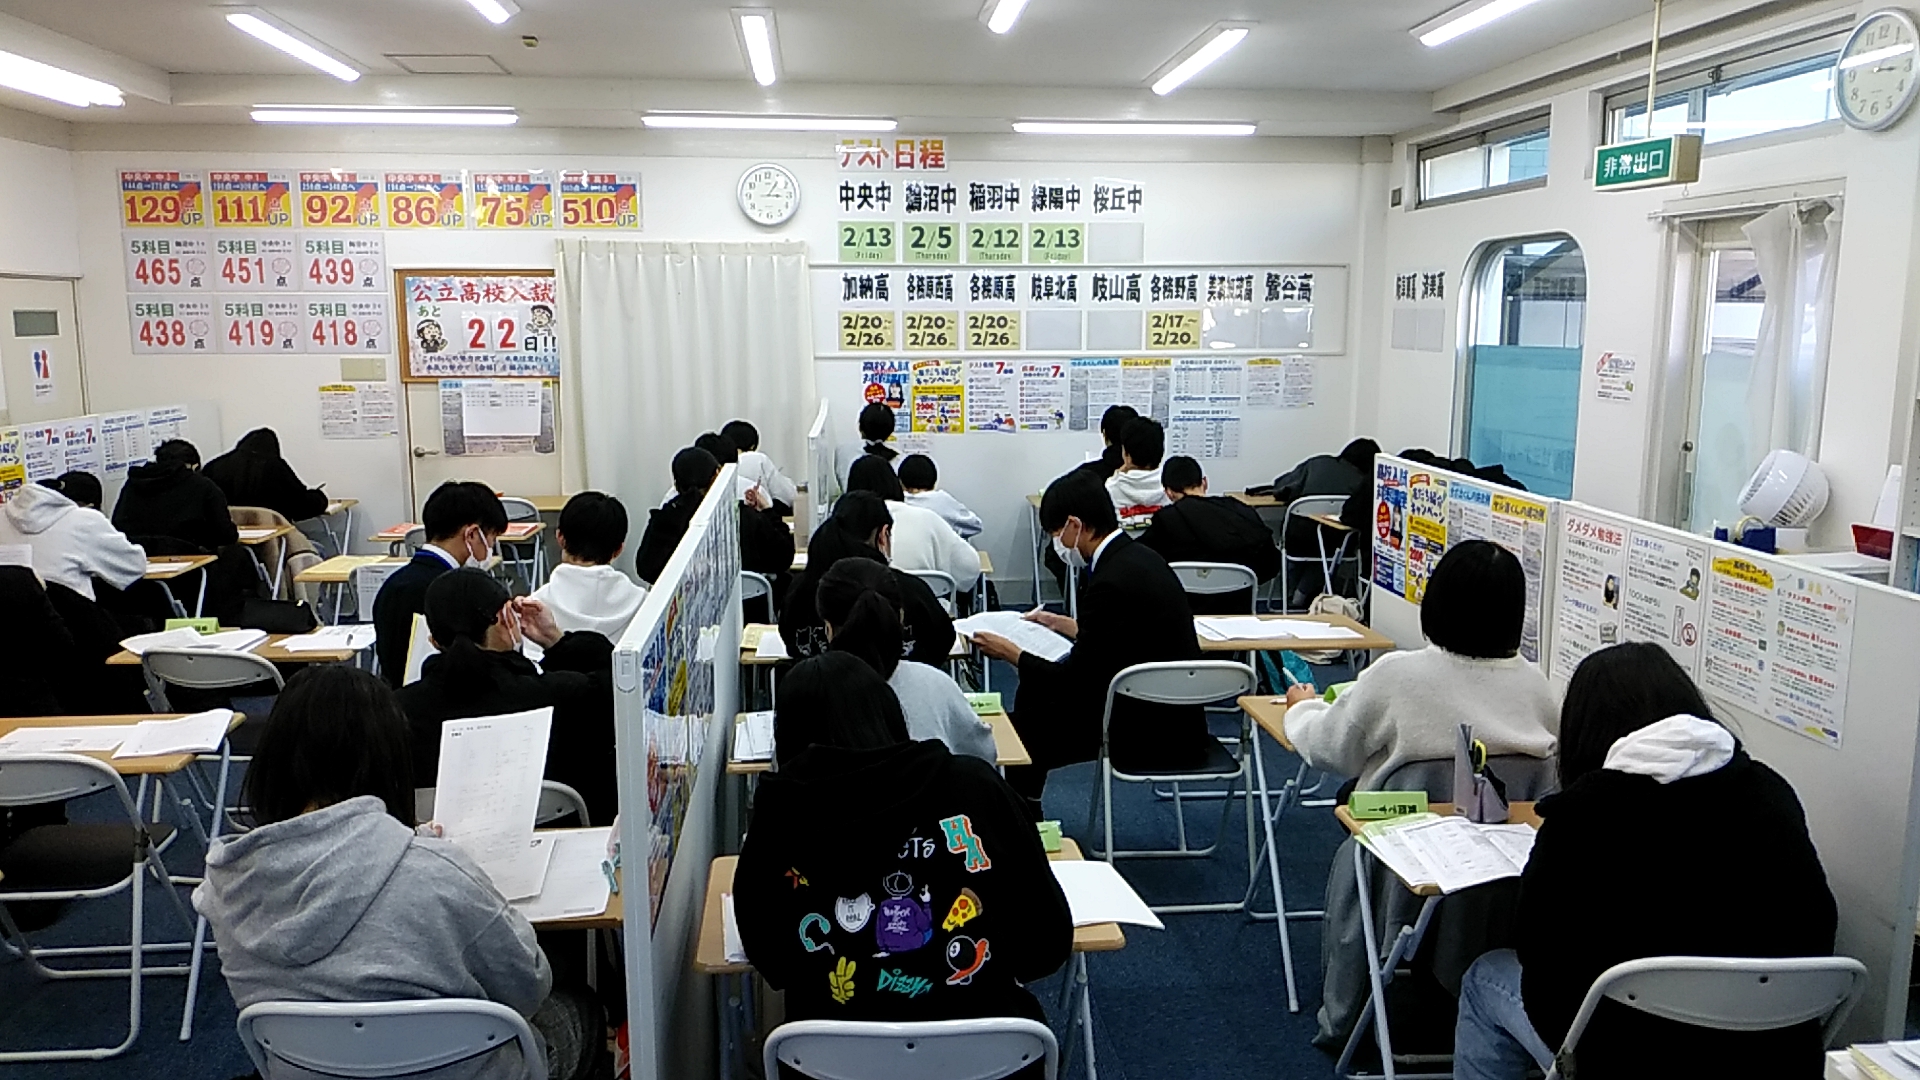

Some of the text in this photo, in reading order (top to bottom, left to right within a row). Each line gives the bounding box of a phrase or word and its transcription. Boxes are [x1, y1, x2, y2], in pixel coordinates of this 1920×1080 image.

[841, 139, 945, 169] テスト日程
[1604, 149, 1664, 177] 非常出口
[839, 180, 891, 211] 中央中
[969, 182, 1020, 212] 稲羽中
[1031, 183, 1081, 212] 緑陽中
[1093, 184, 1142, 214] 桜丘中
[125, 196, 180, 223] 129
[181, 213, 202, 225] UP
[217, 196, 263, 222] 111
[268, 213, 288, 225] UP
[306, 195, 352, 223] 92
[358, 213, 378, 225] UP
[393, 196, 436, 225] 86
[441, 214, 461, 226] UP
[482, 198, 525, 226] 75
[530, 214, 550, 226] UP
[563, 198, 615, 224] 510
[617, 215, 637, 226] UP
[131, 240, 170, 254] 5科目
[217, 240, 257, 254] 5科目
[305, 240, 344, 254] 5科目
[843, 227, 891, 247] 2/13
[911, 226, 952, 248] 2/5
[971, 228, 1019, 248] 2/12
[1033, 228, 1080, 248] 2/13
[135, 258, 201, 287] 465 点
[222, 257, 287, 287] 451 点
[309, 258, 374, 287] 439 点
[412, 282, 554, 303] 公立高校入試
[842, 273, 889, 301] 加納高
[907, 273, 953, 302] 各務原西高
[970, 273, 1016, 302] 各務原高
[1031, 273, 1078, 302] 岐阜北高
[1092, 273, 1141, 302] 岐山高
[1150, 274, 1198, 302] 各務野高
[1265, 272, 1313, 302] 鶯谷高
[135, 303, 174, 317] 5科目
[225, 303, 263, 317] 5科目
[308, 303, 347, 317] 5科目
[417, 306, 441, 317] あと
[140, 320, 205, 349] 438 点
[229, 320, 294, 349] 419 点
[312, 320, 377, 349] 418 点
[468, 318, 516, 348] 22
[846, 332, 884, 347] 2/26
[909, 331, 947, 347] 2/26
[972, 331, 1009, 347] 2/26
[1153, 331, 1191, 346] 2/20
[1567, 518, 1622, 546] ダメダメ勉強法
